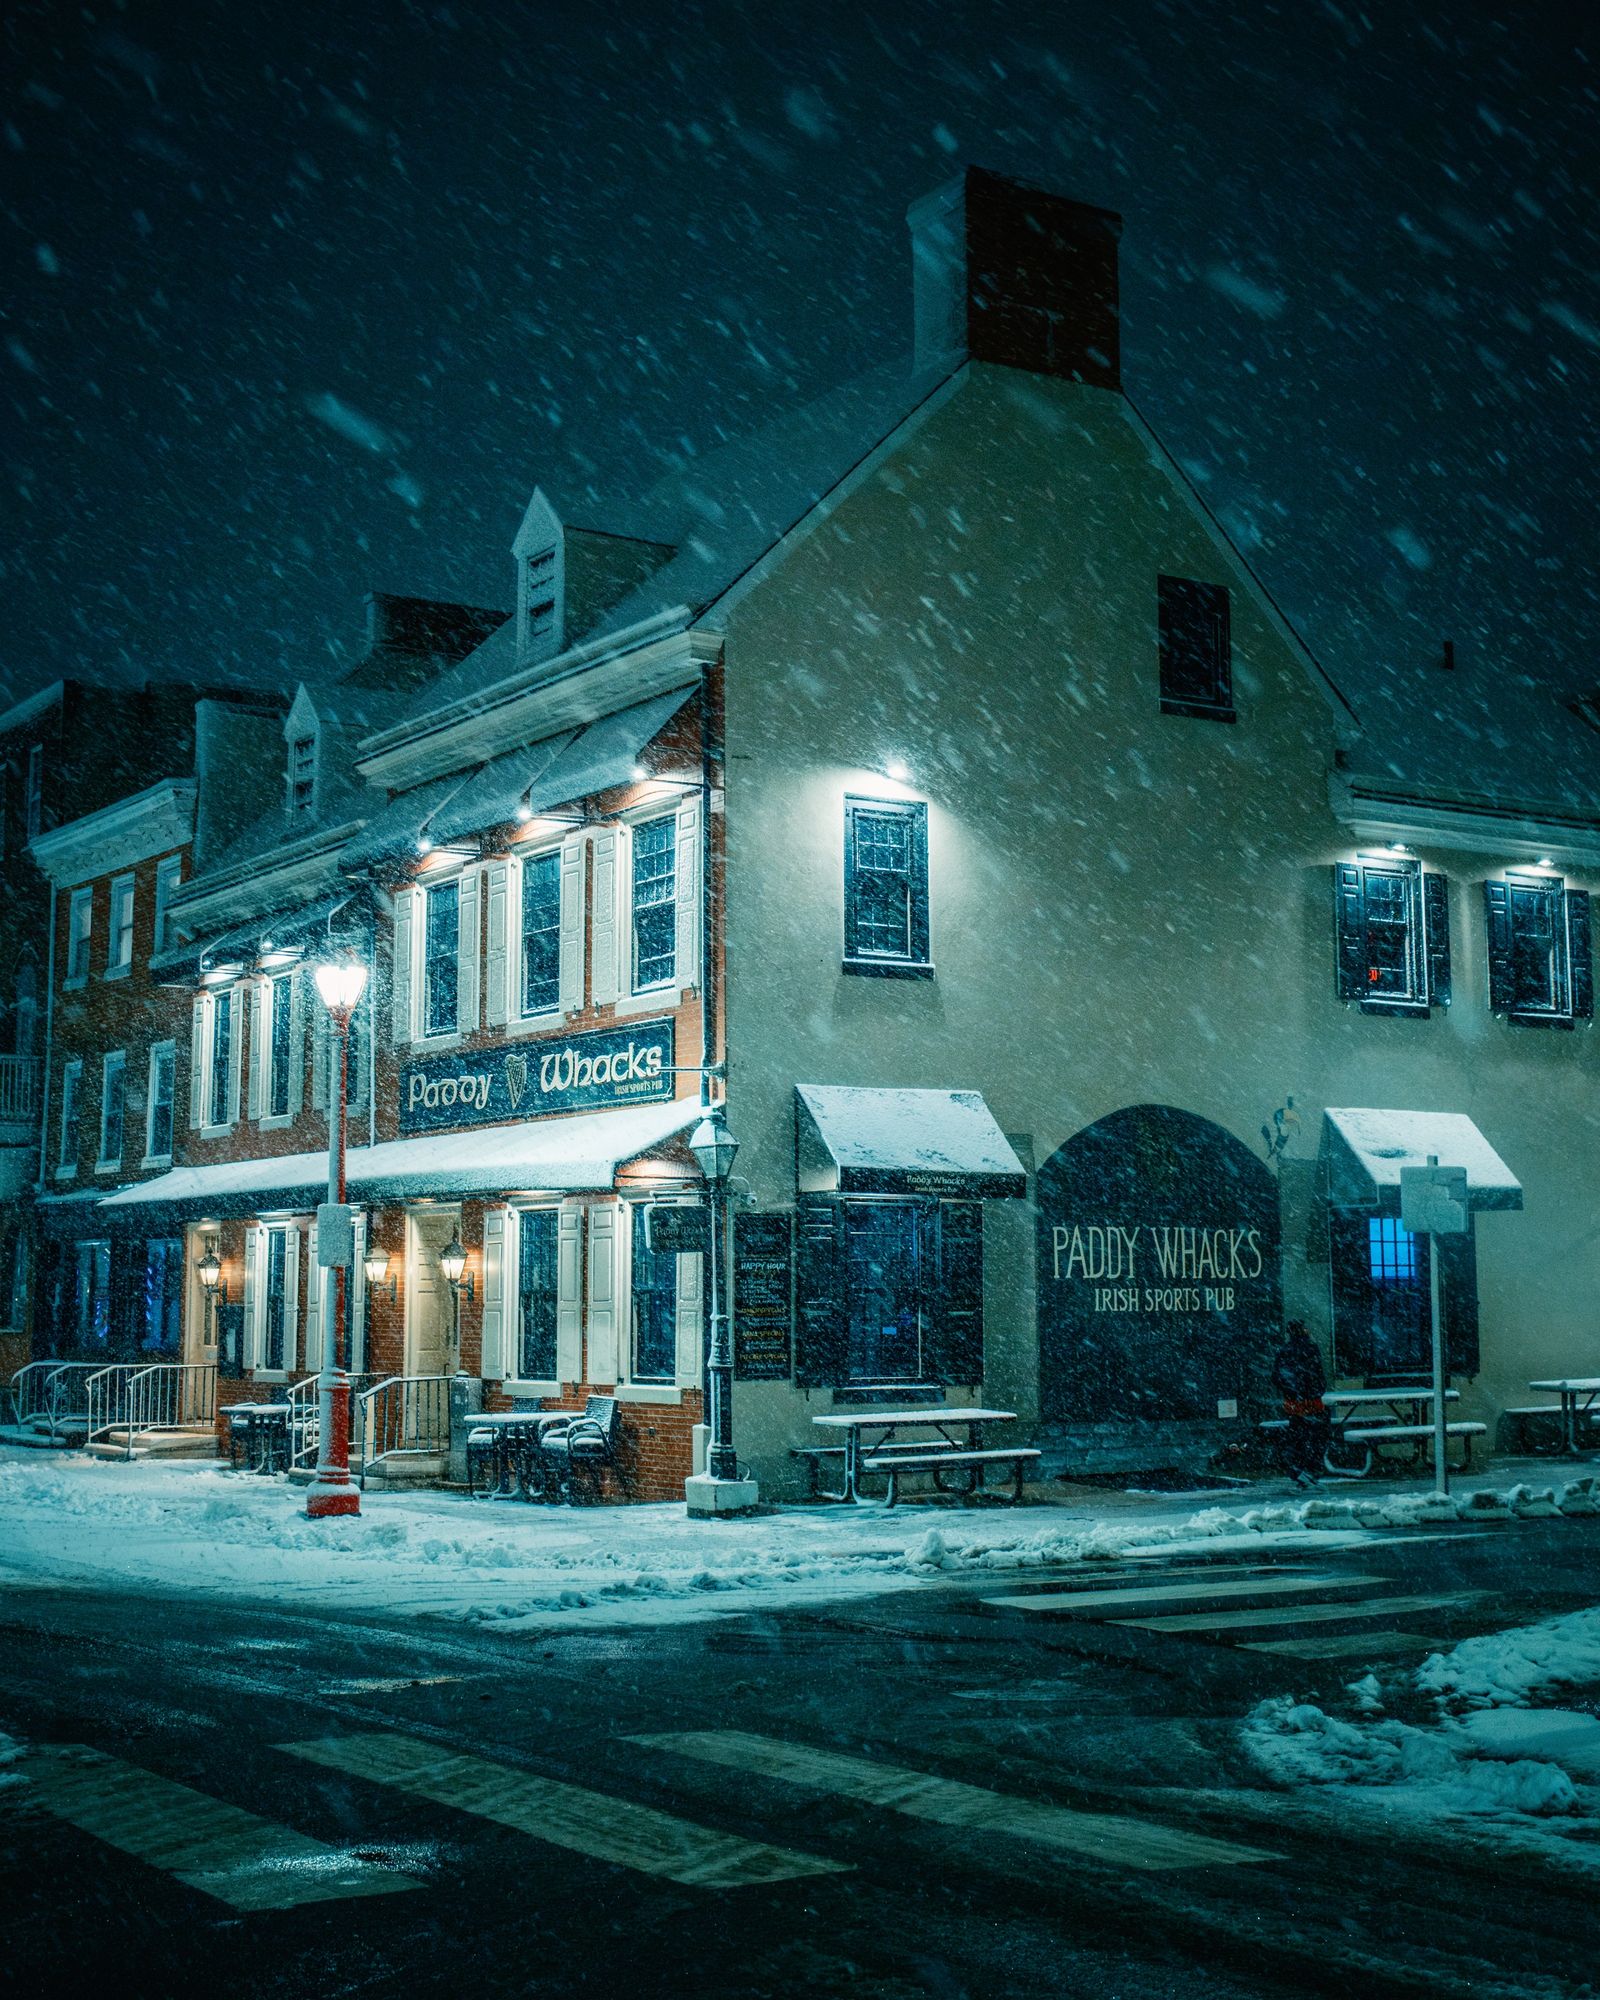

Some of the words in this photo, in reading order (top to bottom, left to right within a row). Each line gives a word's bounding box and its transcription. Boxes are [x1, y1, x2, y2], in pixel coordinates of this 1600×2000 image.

[409, 1074, 493, 1112] Paddy
[540, 1042, 663, 1093] Whacks
[630, 1081, 650, 1093] SPORTS
[652, 1080, 663, 1090] PUB
[1052, 1224, 1141, 1279] PADDY
[1151, 1225, 1262, 1279] WHACKS
[1095, 1288, 1139, 1312] IRISH
[1144, 1288, 1200, 1312] SPORTS
[1205, 1288, 1235, 1312] PUB
